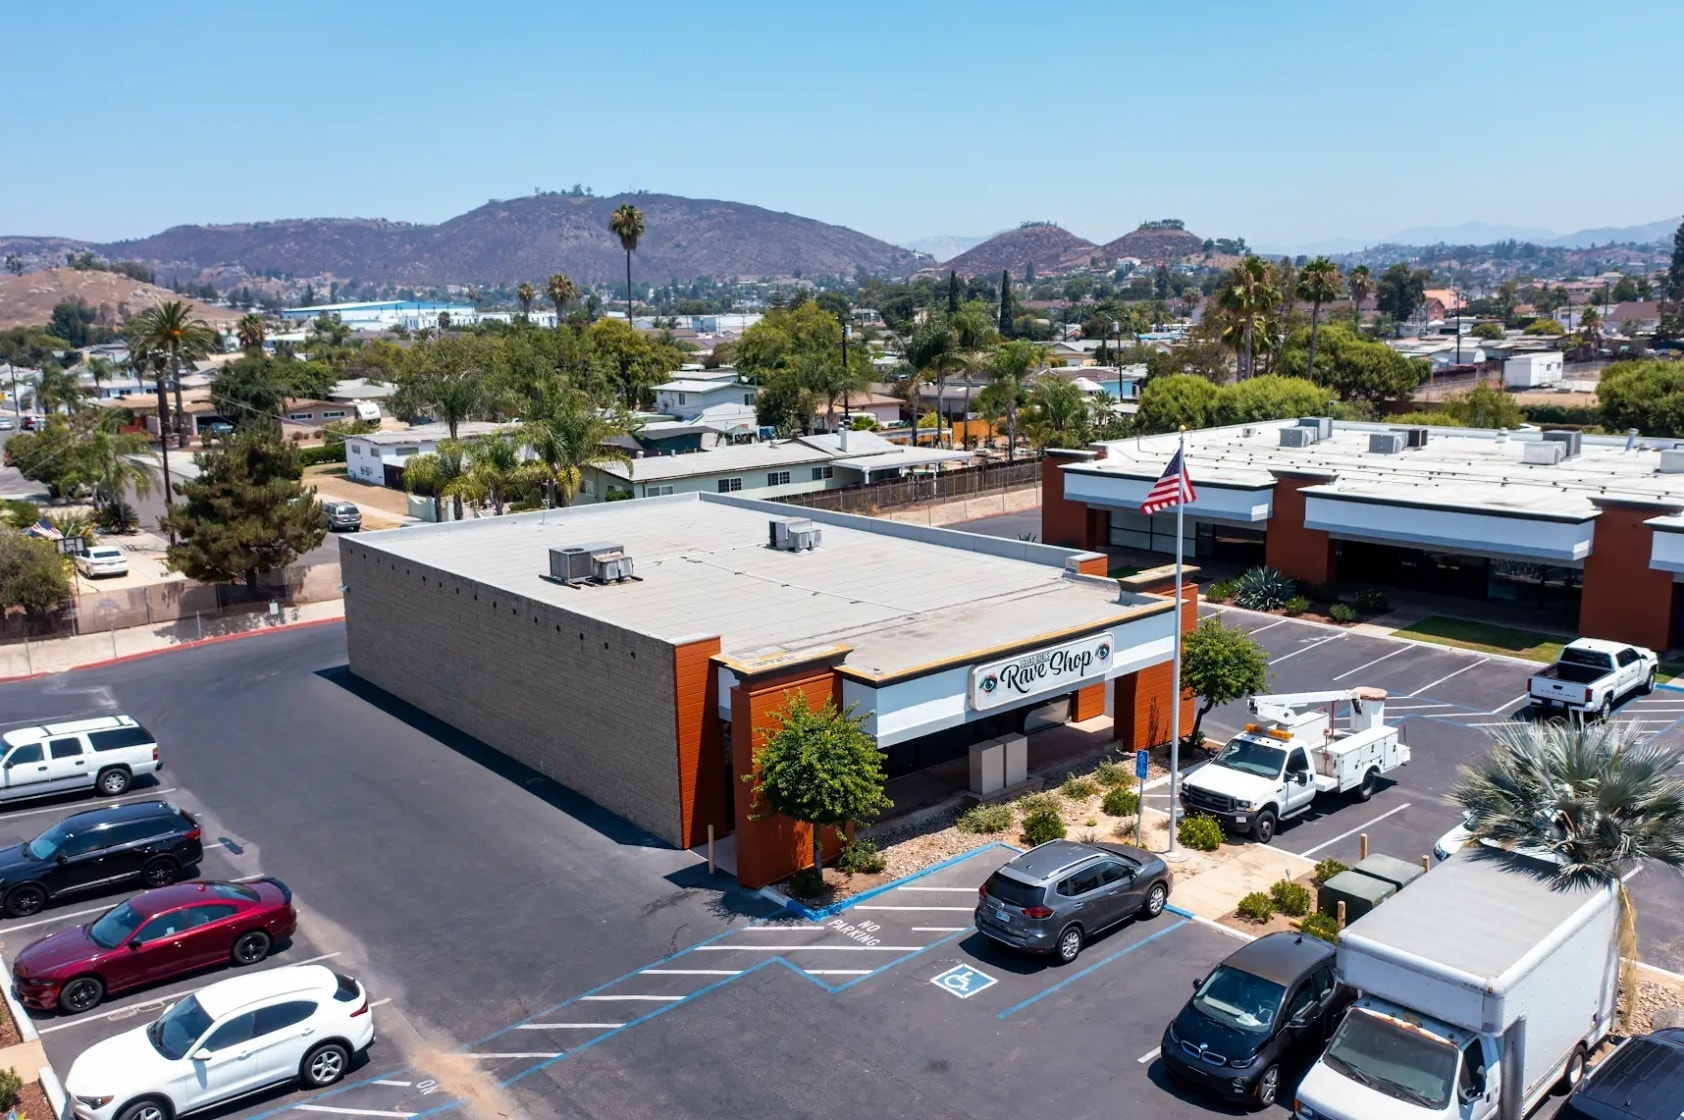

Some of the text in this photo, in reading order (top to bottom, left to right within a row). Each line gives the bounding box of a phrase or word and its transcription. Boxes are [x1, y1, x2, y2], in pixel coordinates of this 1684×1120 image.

[1000, 650, 1093, 693] Rave Shop
[828, 919, 880, 946] PARKING
[858, 920, 880, 932] NO
